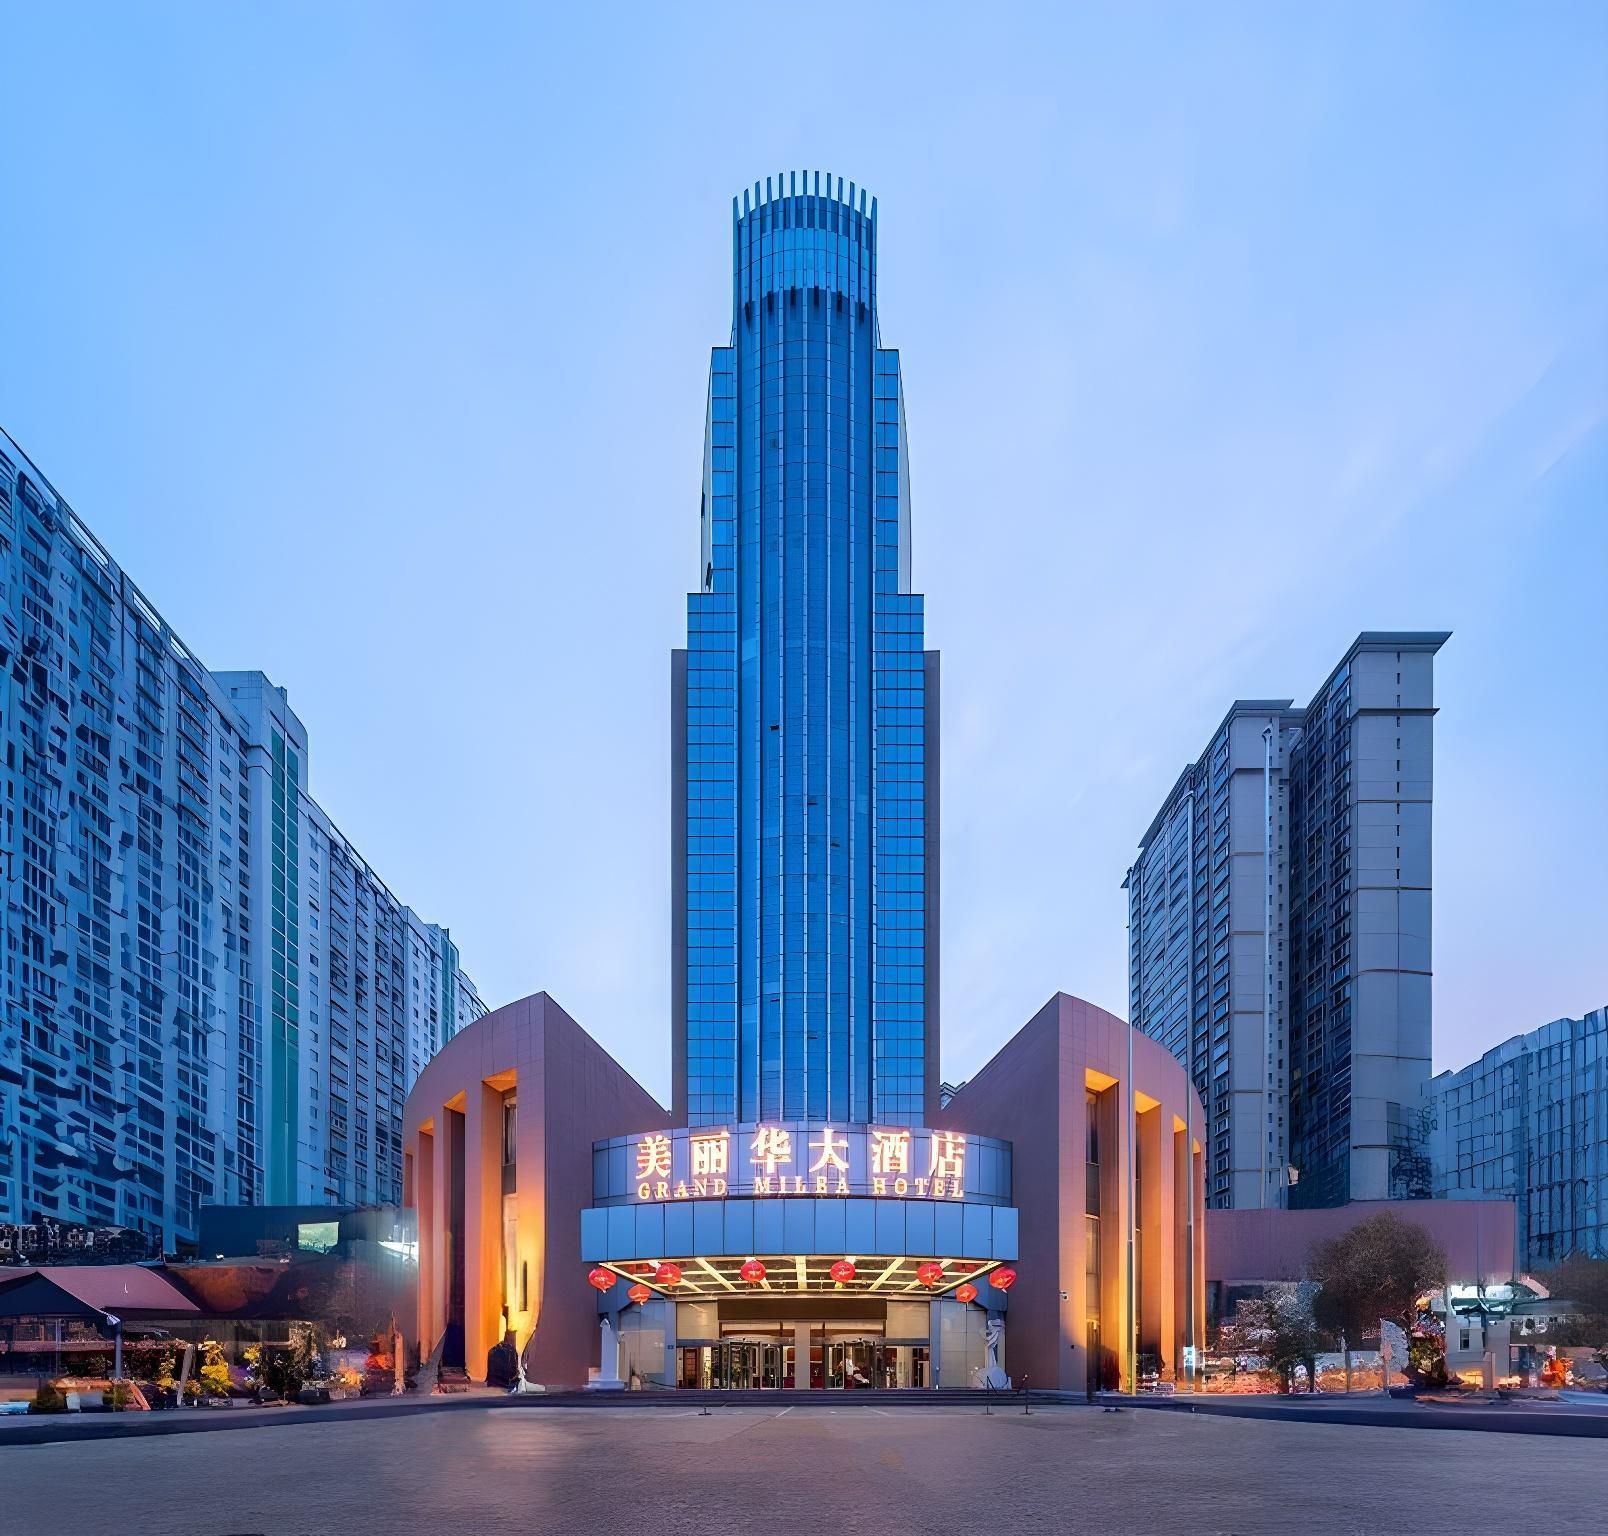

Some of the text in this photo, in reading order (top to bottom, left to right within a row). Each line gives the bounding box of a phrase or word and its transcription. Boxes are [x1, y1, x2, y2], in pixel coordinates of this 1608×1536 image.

[635, 1127, 966, 1179] 美丽华大酒店
[638, 1178, 728, 1200] GRAND
[872, 1177, 964, 1198] HOTEL
